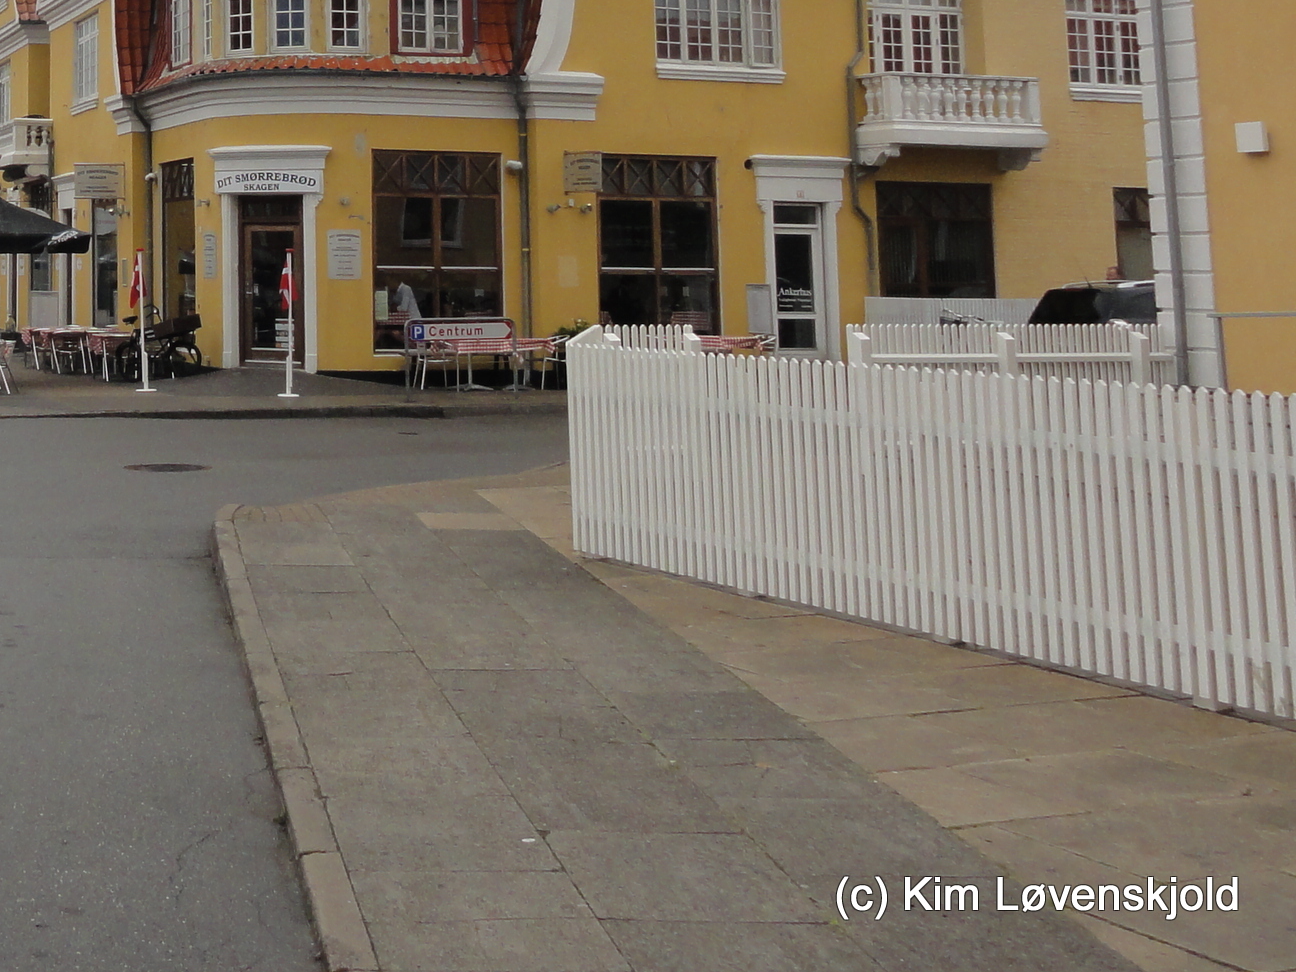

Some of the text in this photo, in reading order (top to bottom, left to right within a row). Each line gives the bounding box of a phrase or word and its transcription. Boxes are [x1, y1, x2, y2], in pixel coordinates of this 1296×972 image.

[217, 172, 317, 189] DIT SMØRREBRØD
[244, 183, 280, 191] SKAGEN
[777, 288, 813, 297] Ankerhus
[413, 326, 484, 339] P Centrum
